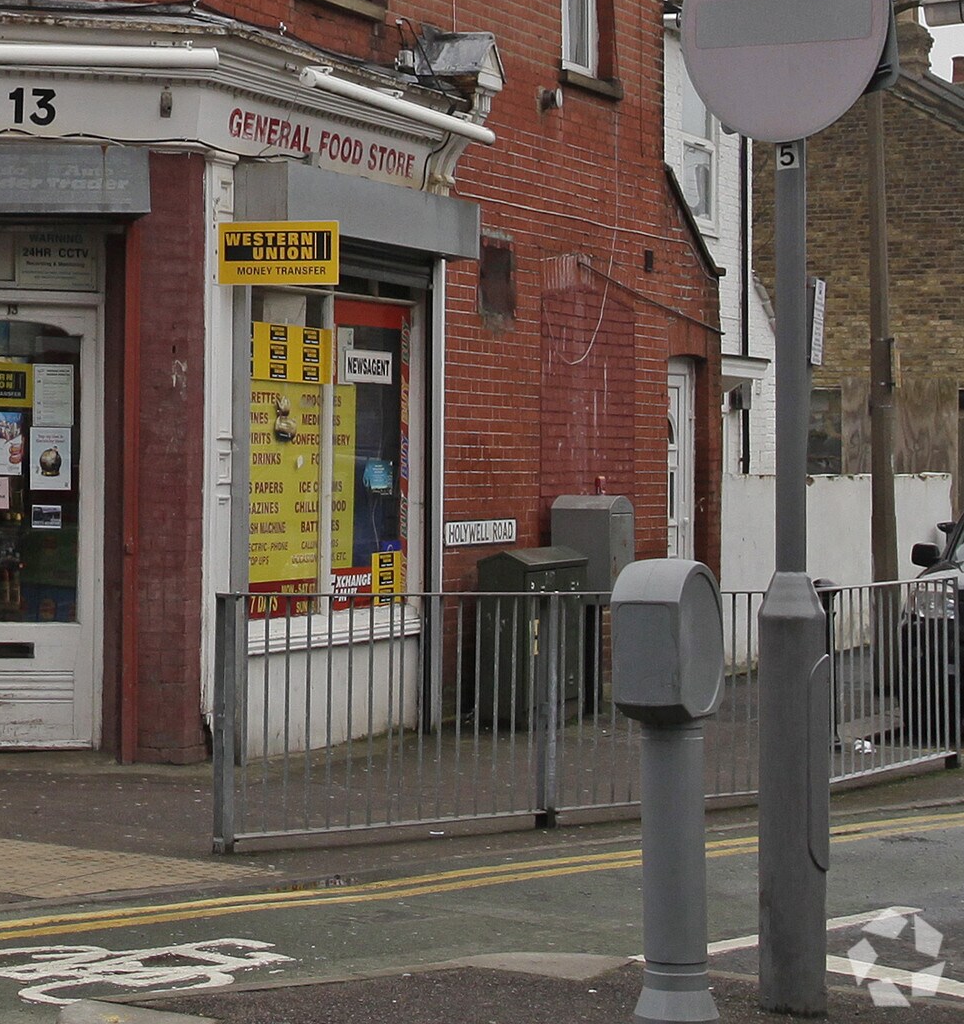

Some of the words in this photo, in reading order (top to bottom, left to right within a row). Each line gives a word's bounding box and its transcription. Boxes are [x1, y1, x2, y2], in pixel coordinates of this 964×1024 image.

[9, 87, 56, 126] 13
[228, 107, 311, 153] GENERAL
[319, 130, 363, 165] FOOD
[367, 143, 416, 178] STORE
[780, 144, 794, 166] 5
[225, 232, 313, 246] WESTERN
[22, 248, 51, 258] 24HR
[58, 248, 89, 258] CCTV
[252, 247, 313, 260] UNION
[237, 267, 273, 275] MONEY
[276, 267, 326, 275] TRANSFER
[7, 304, 18, 315] 13
[347, 357, 390, 376] NEWSAGENT
[252, 392, 281, 404] RETTES
[250, 412, 268, 424] INES
[251, 433, 271, 444] IRITS
[253, 453, 281, 465] DRINKS
[255, 482, 284, 494] PAPERS
[299, 481, 311, 493] ICE
[249, 502, 279, 514] AZINES
[332, 500, 347, 512] OOD
[448, 523, 489, 543] HOLYWELL
[493, 522, 513, 540] ROAD
